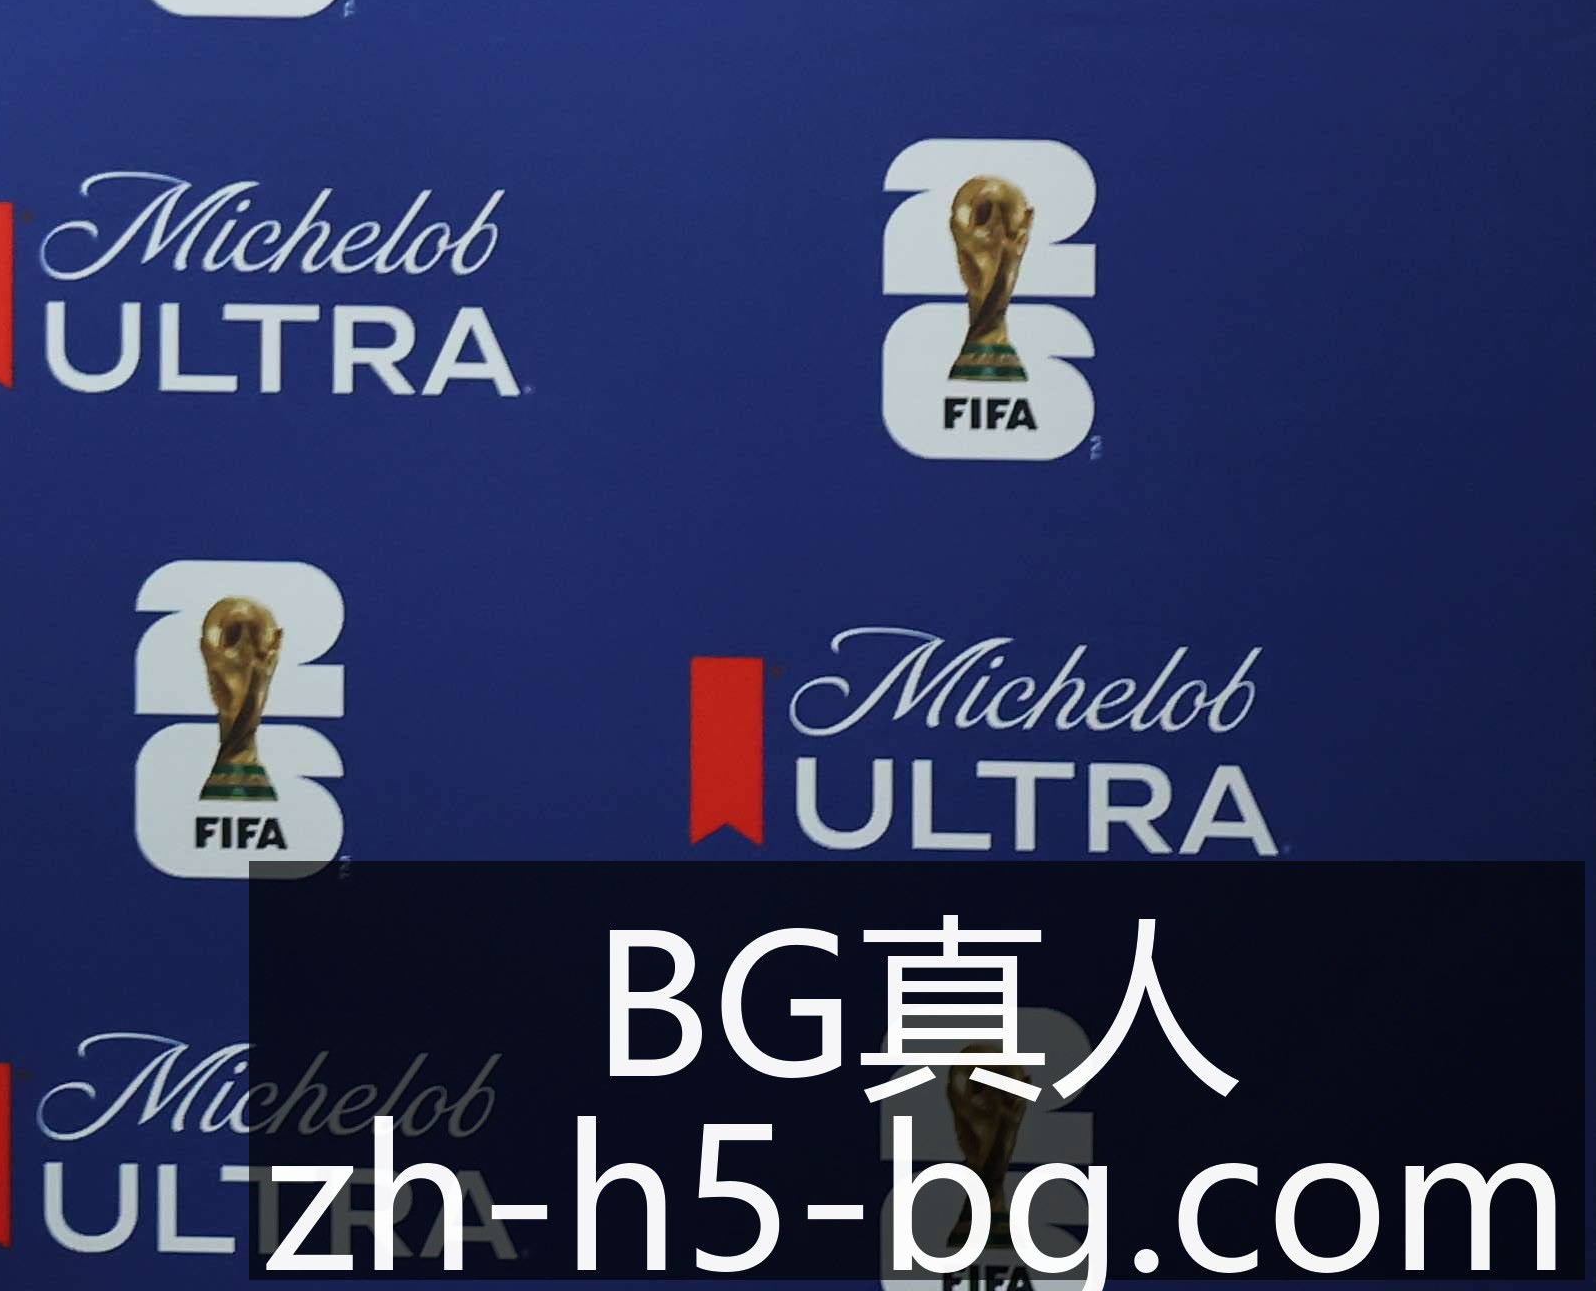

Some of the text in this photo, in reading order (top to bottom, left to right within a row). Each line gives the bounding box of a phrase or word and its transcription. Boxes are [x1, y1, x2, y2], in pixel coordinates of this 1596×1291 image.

[40, 171, 505, 280] Michelob
[45, 300, 521, 397] ULTRA
[945, 398, 1037, 430] FIFA
[789, 627, 1262, 736] Michelob
[195, 819, 288, 851] FIFA
[796, 757, 1279, 856] ULTRA
[37, 1032, 502, 1142] Michelob
